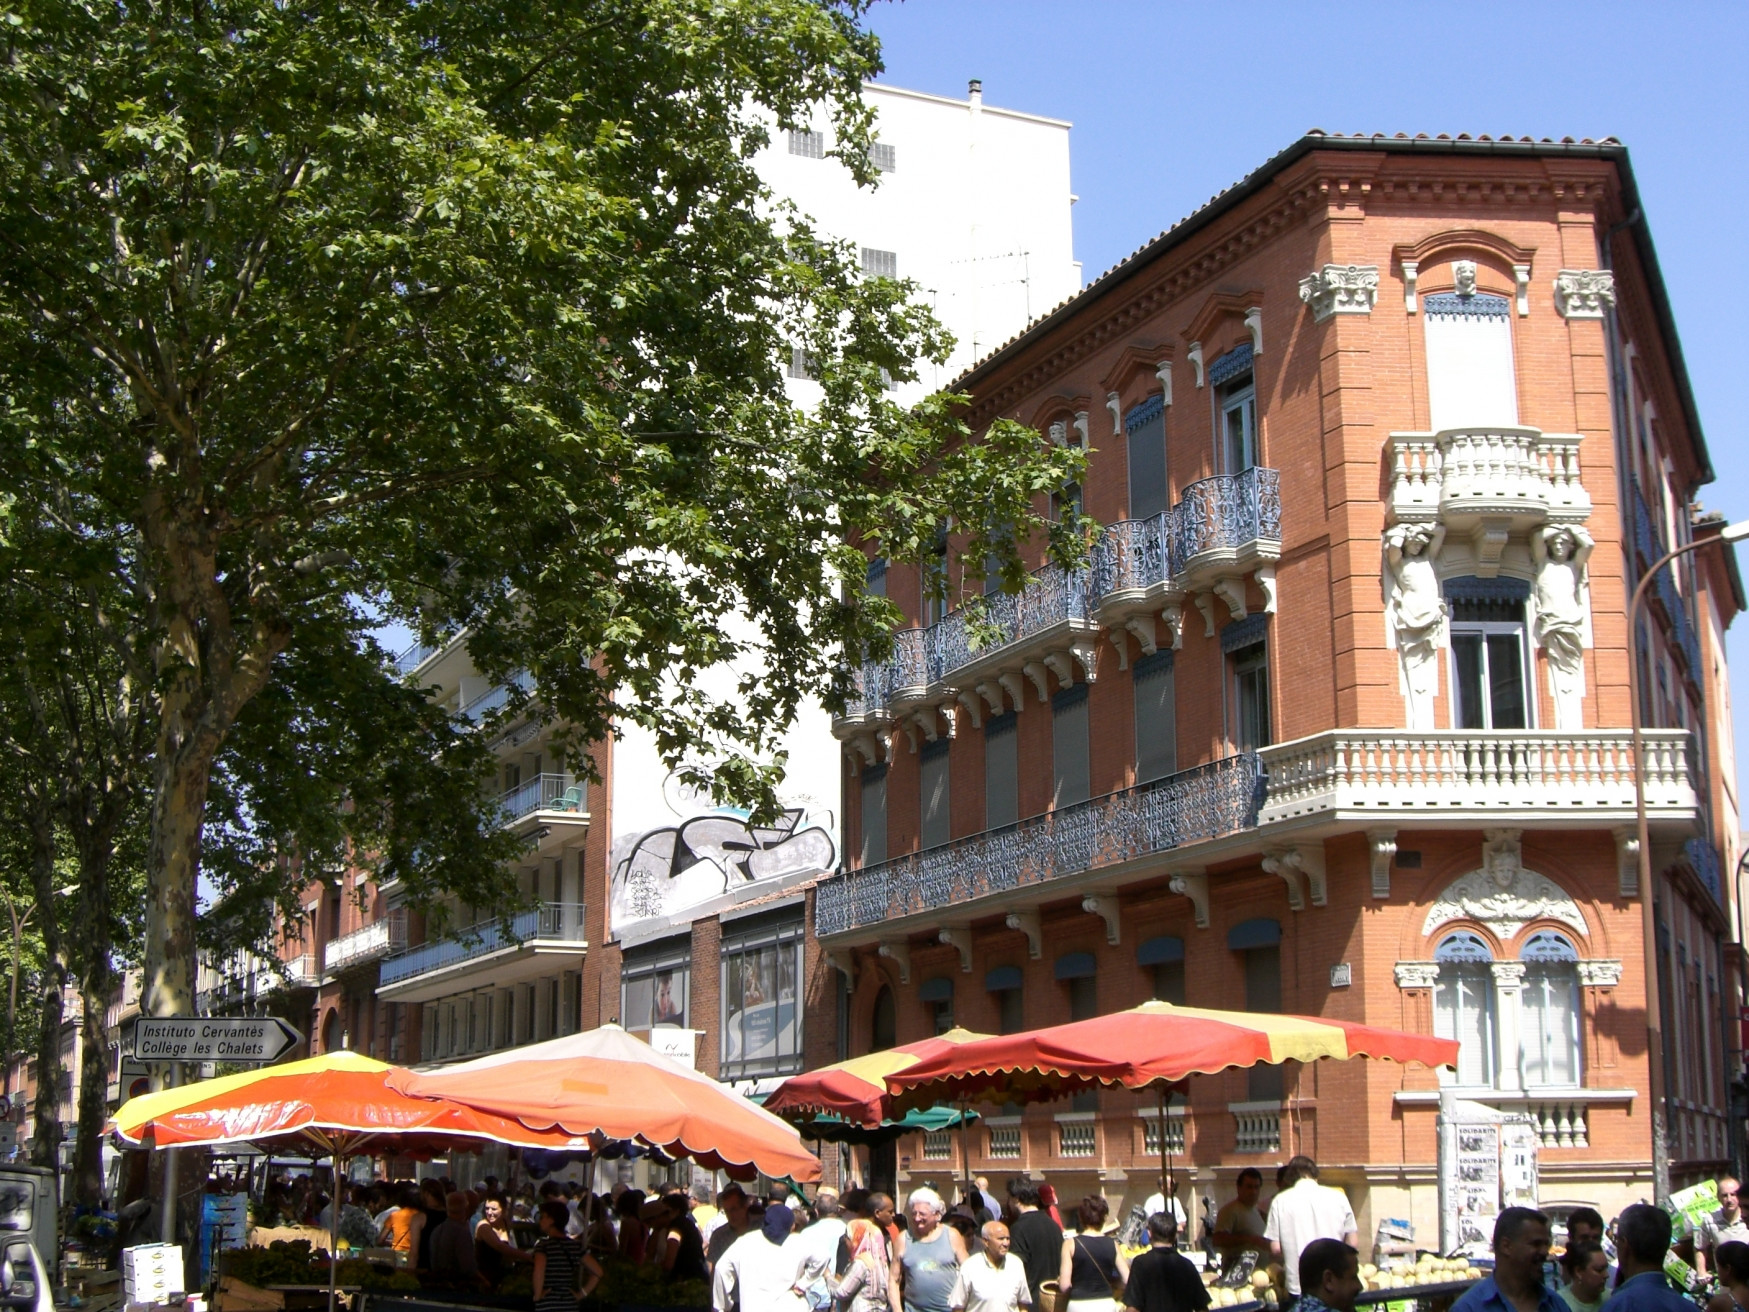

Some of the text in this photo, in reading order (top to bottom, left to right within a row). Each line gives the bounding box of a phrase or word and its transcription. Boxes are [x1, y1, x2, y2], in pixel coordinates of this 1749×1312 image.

[143, 1025, 196, 1038] Instituto
[142, 1041, 264, 1057] Collège les Chalets
